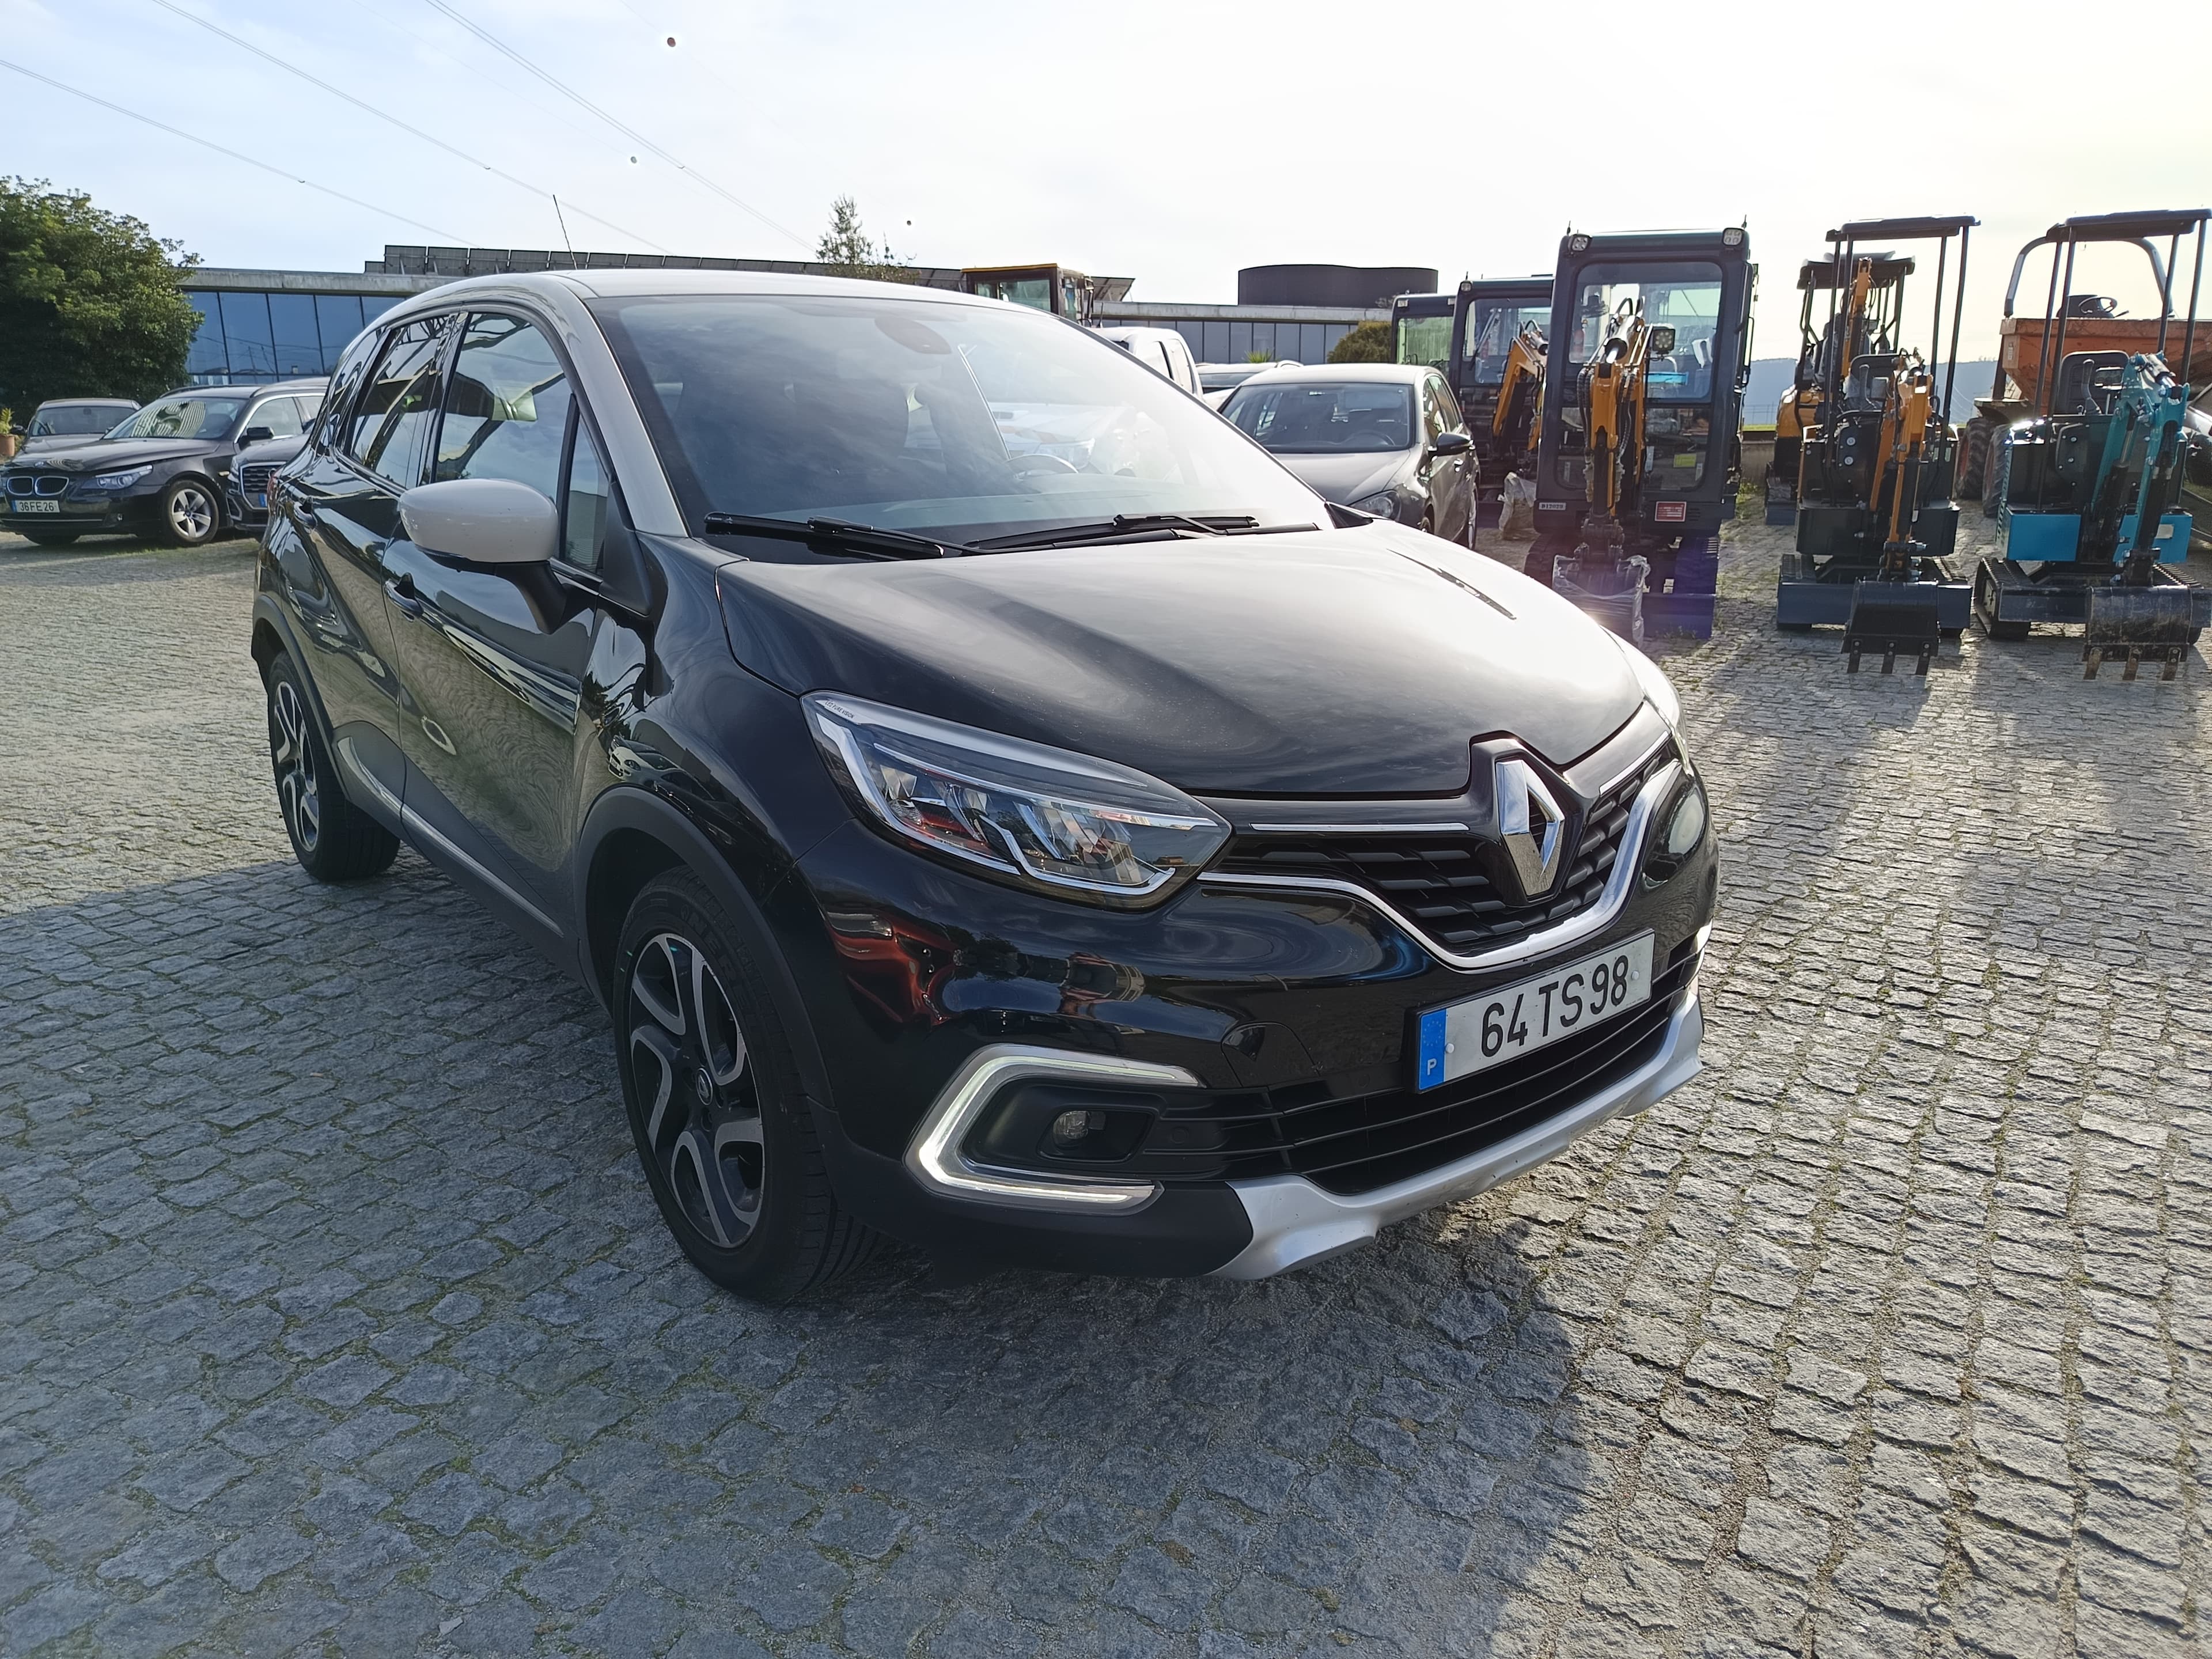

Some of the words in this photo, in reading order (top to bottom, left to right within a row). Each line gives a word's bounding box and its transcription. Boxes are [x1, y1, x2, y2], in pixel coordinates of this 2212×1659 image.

[19, 502, 54, 512] 36FE26
[1481, 955, 1628, 1058] 64TS98
[1426, 1058, 1437, 1075] P
